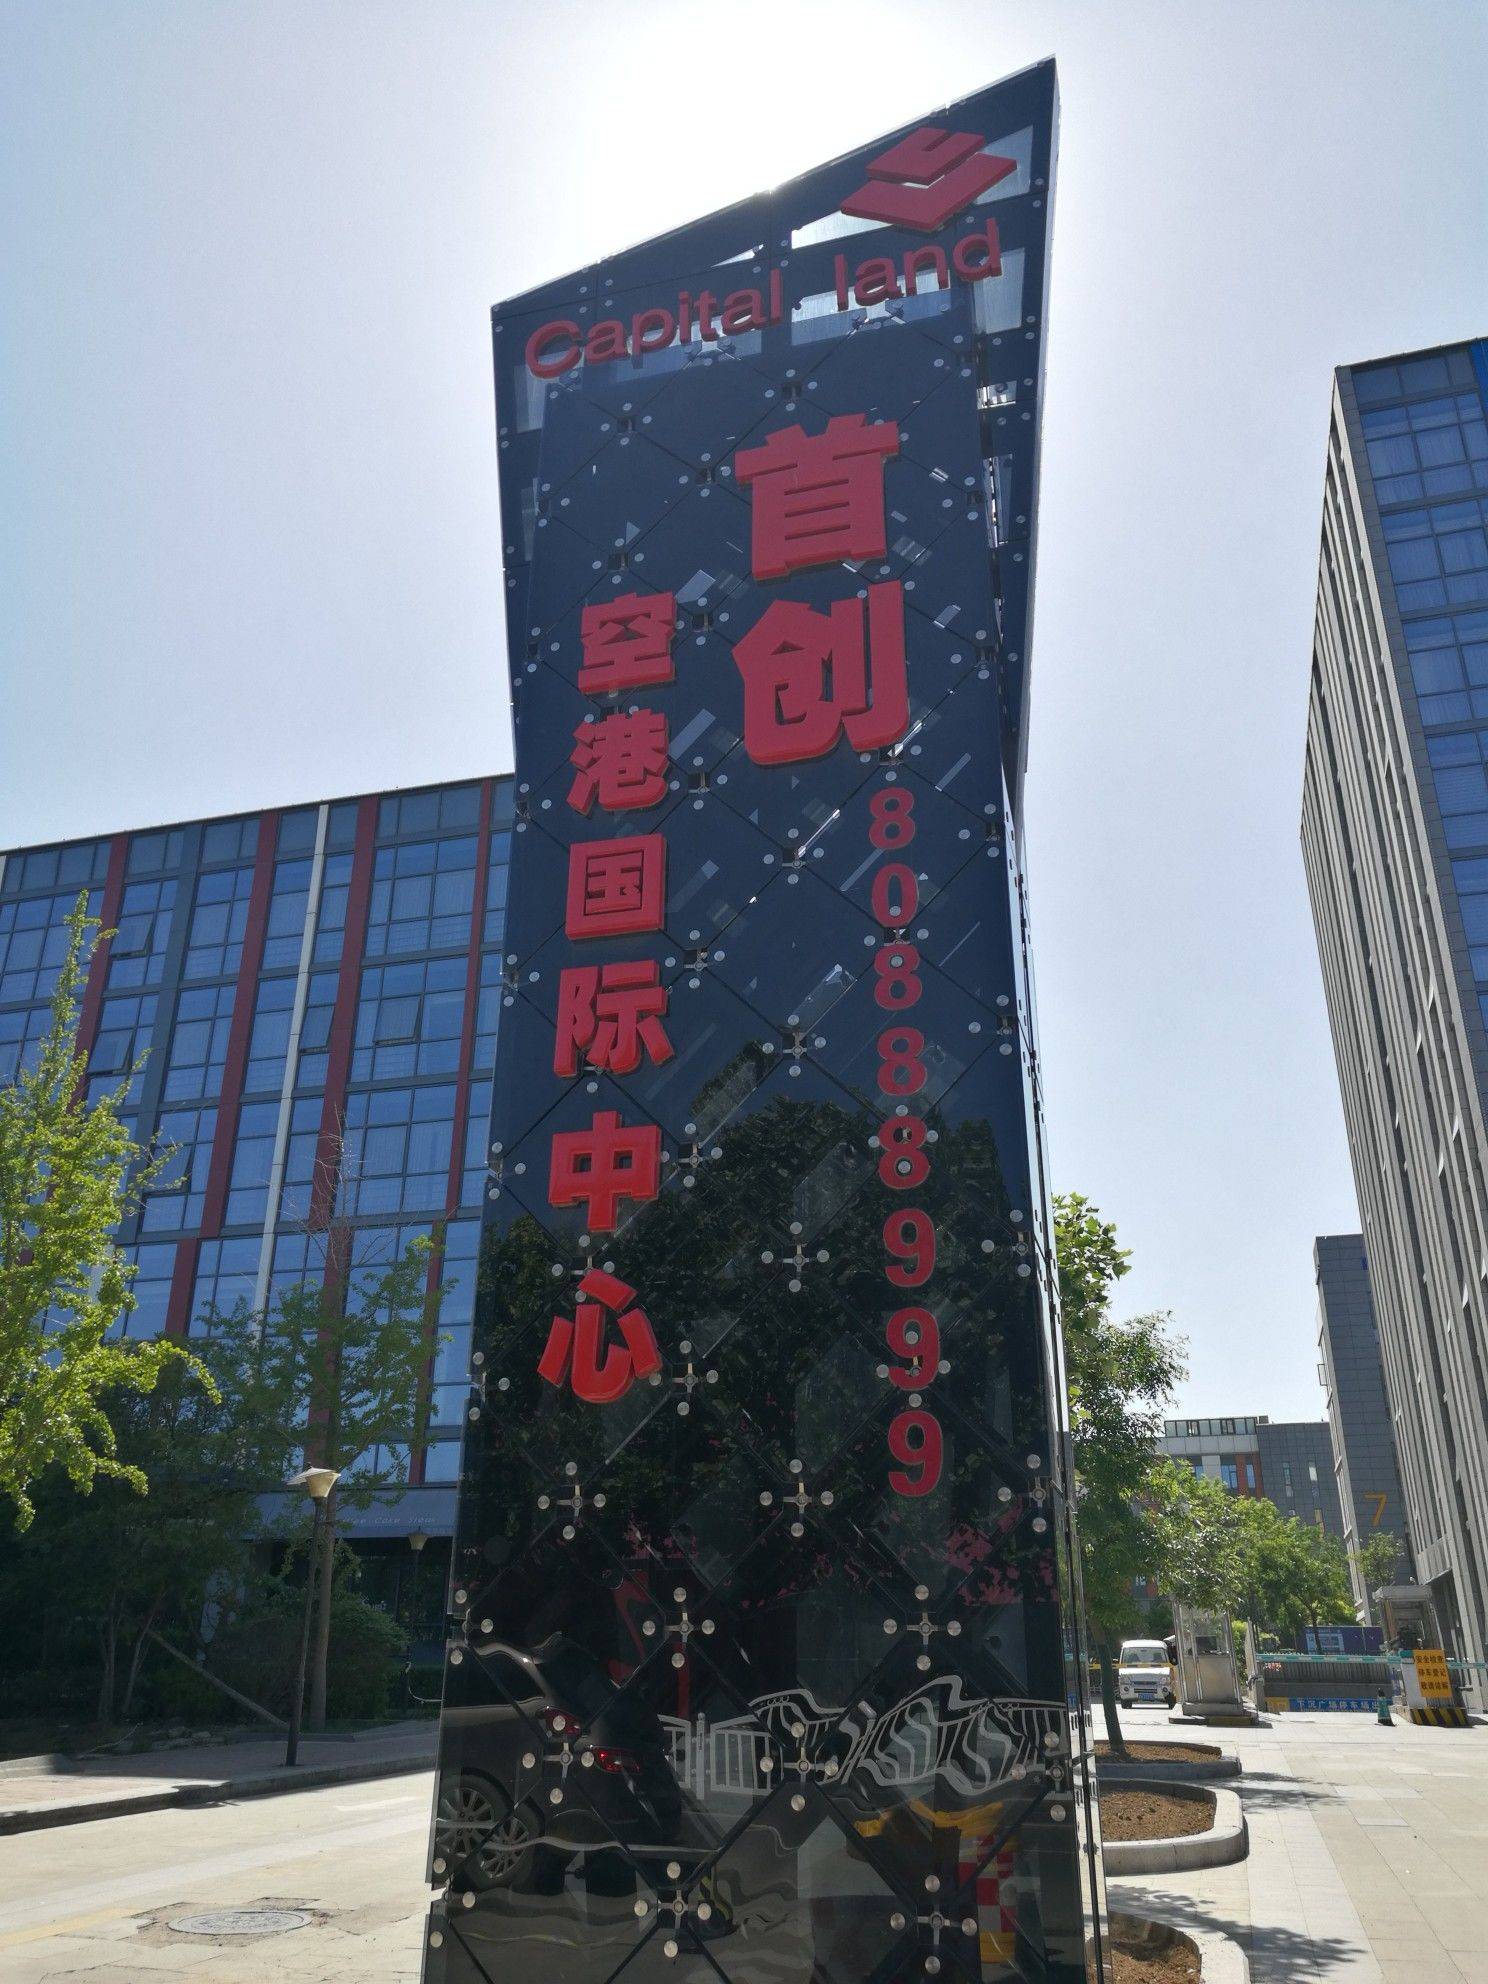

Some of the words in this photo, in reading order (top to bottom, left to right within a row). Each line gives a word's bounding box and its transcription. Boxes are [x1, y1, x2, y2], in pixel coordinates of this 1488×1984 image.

[525, 268, 783, 379] Capital
[834, 217, 1002, 312] land
[731, 413, 911, 766] 首创
[537, 590, 677, 1403] 空港国际中心
[868, 786, 943, 1496] 80888999
[1363, 1492, 1387, 1526] 7
